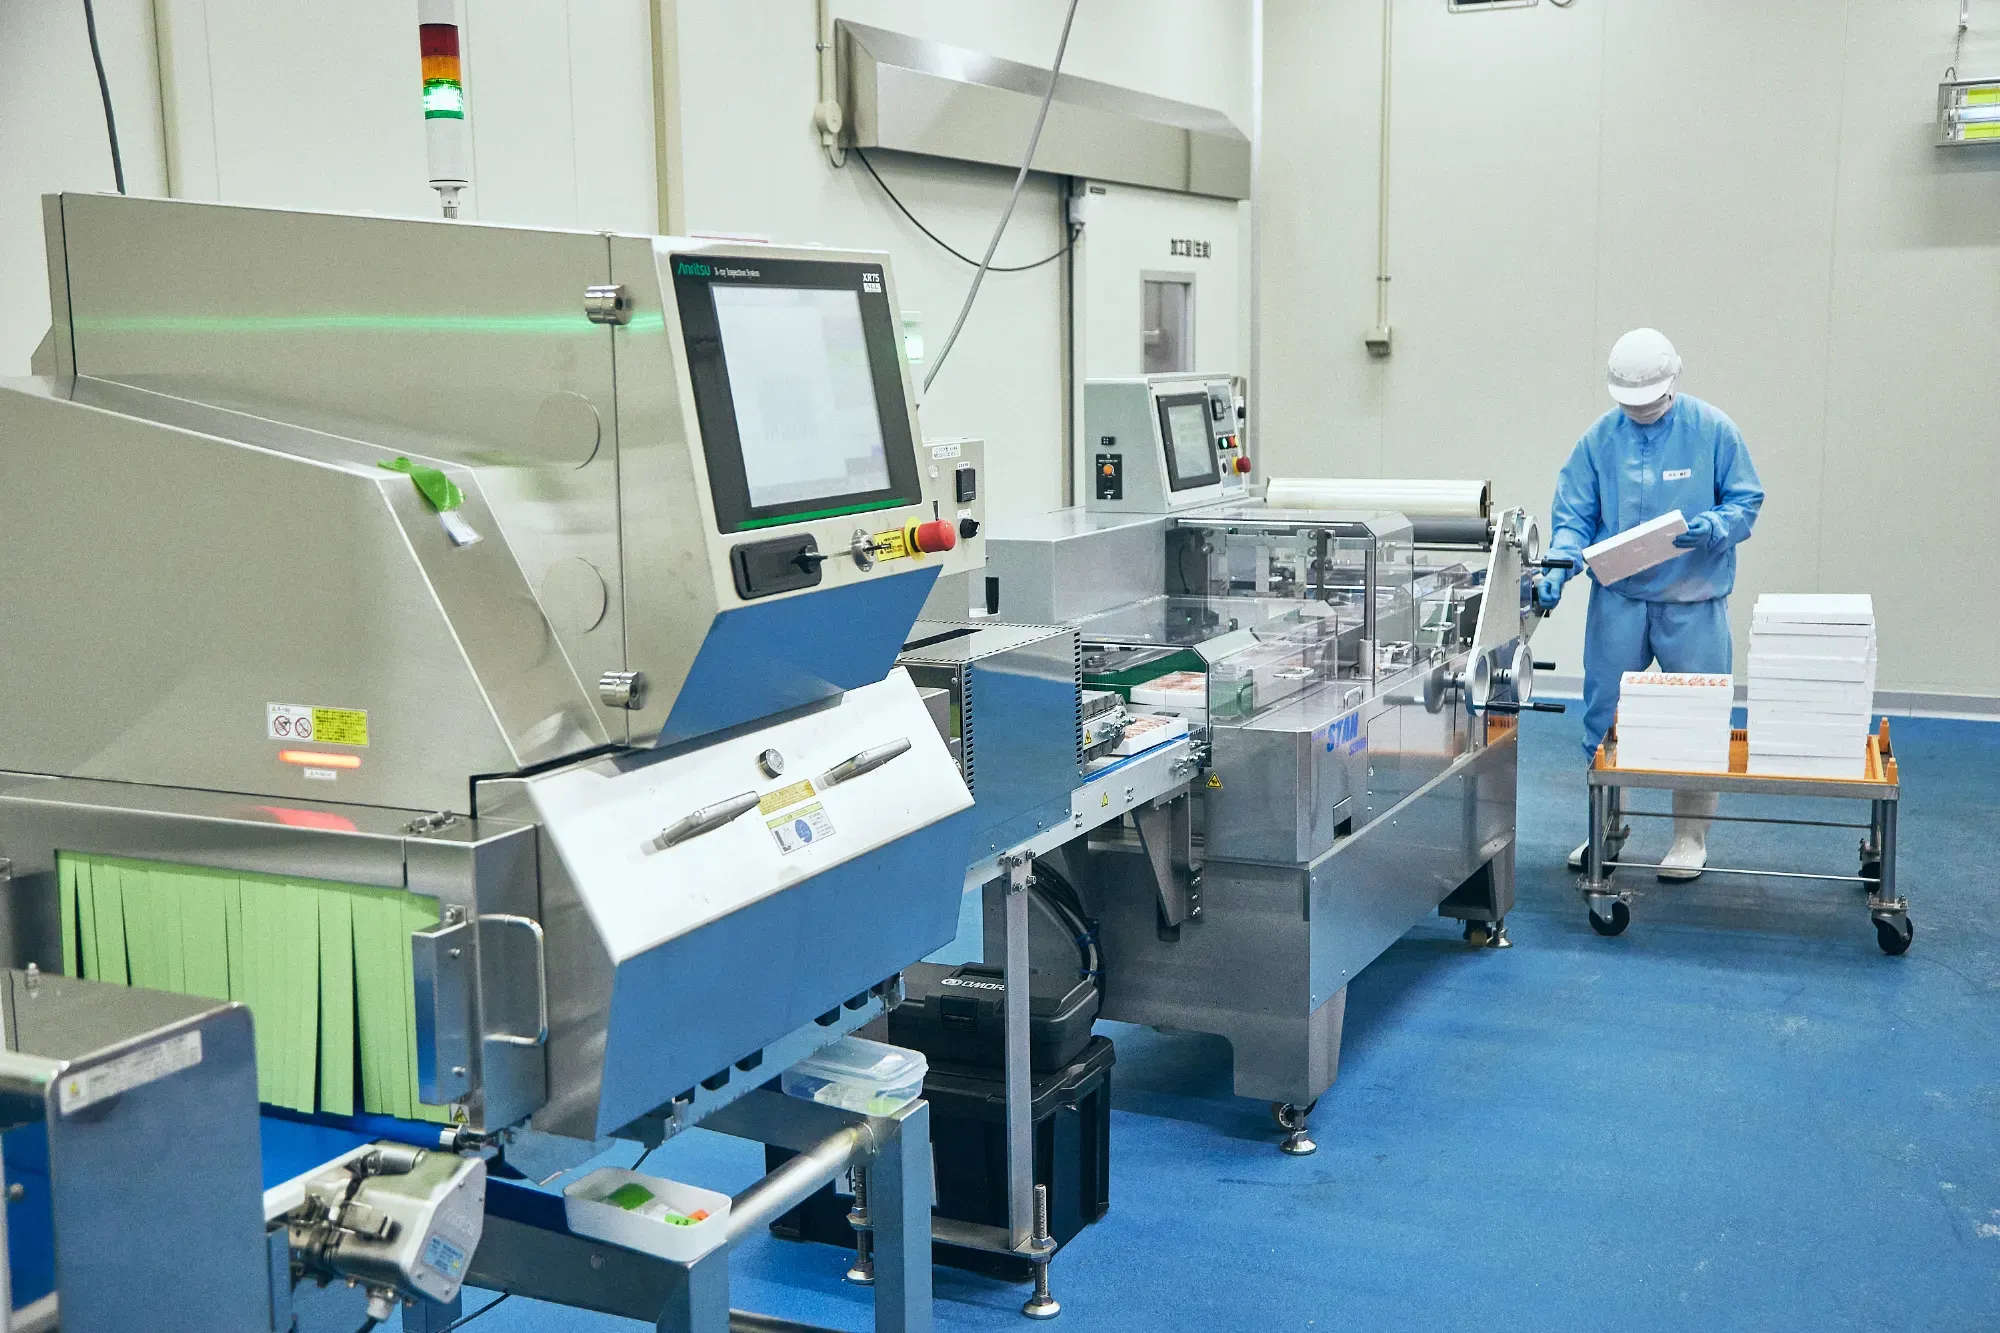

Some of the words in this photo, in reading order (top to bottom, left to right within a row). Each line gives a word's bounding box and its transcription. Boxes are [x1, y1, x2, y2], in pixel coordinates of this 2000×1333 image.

[678, 262, 711, 276] Anritsu
[862, 273, 880, 282] XR75
[961, 981, 1005, 991] OMOR
